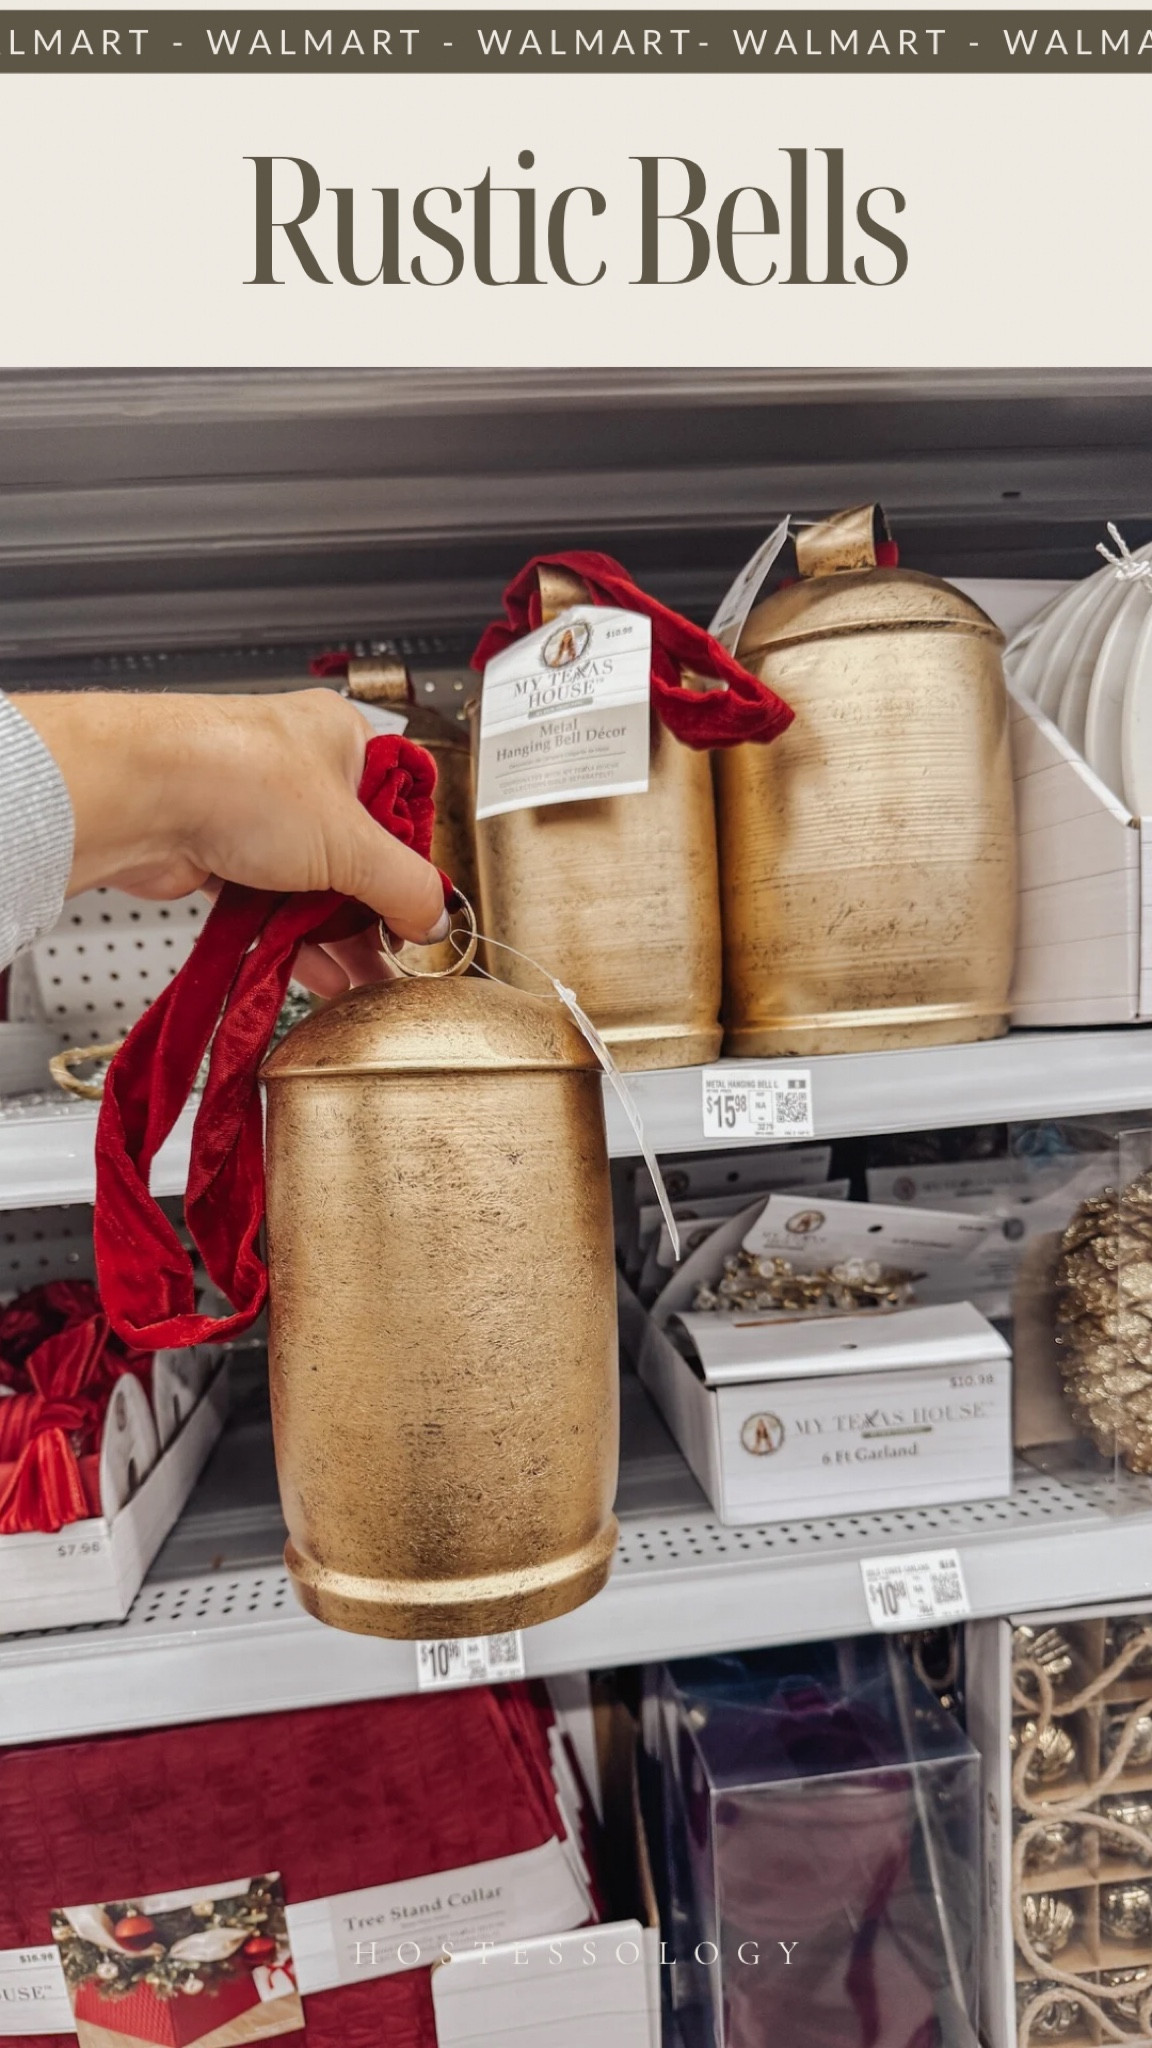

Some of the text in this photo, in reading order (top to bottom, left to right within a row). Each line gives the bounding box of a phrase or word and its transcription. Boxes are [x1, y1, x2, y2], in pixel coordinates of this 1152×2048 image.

[513, 659, 614, 698] MY TEXAS
[496, 738, 551, 762] Hanging
[555, 730, 580, 748] Bell
[585, 725, 627, 743] Décor
[538, 717, 578, 738] Metal
[795, 1418, 823, 1436] MY
[832, 1409, 905, 1432] TEXAS
[835, 1449, 852, 1464] Ft
[854, 1442, 920, 1462] Garland
[343, 1913, 386, 1932] Tree
[390, 1897, 443, 1921] Stand
[447, 1885, 503, 1908] Collar
